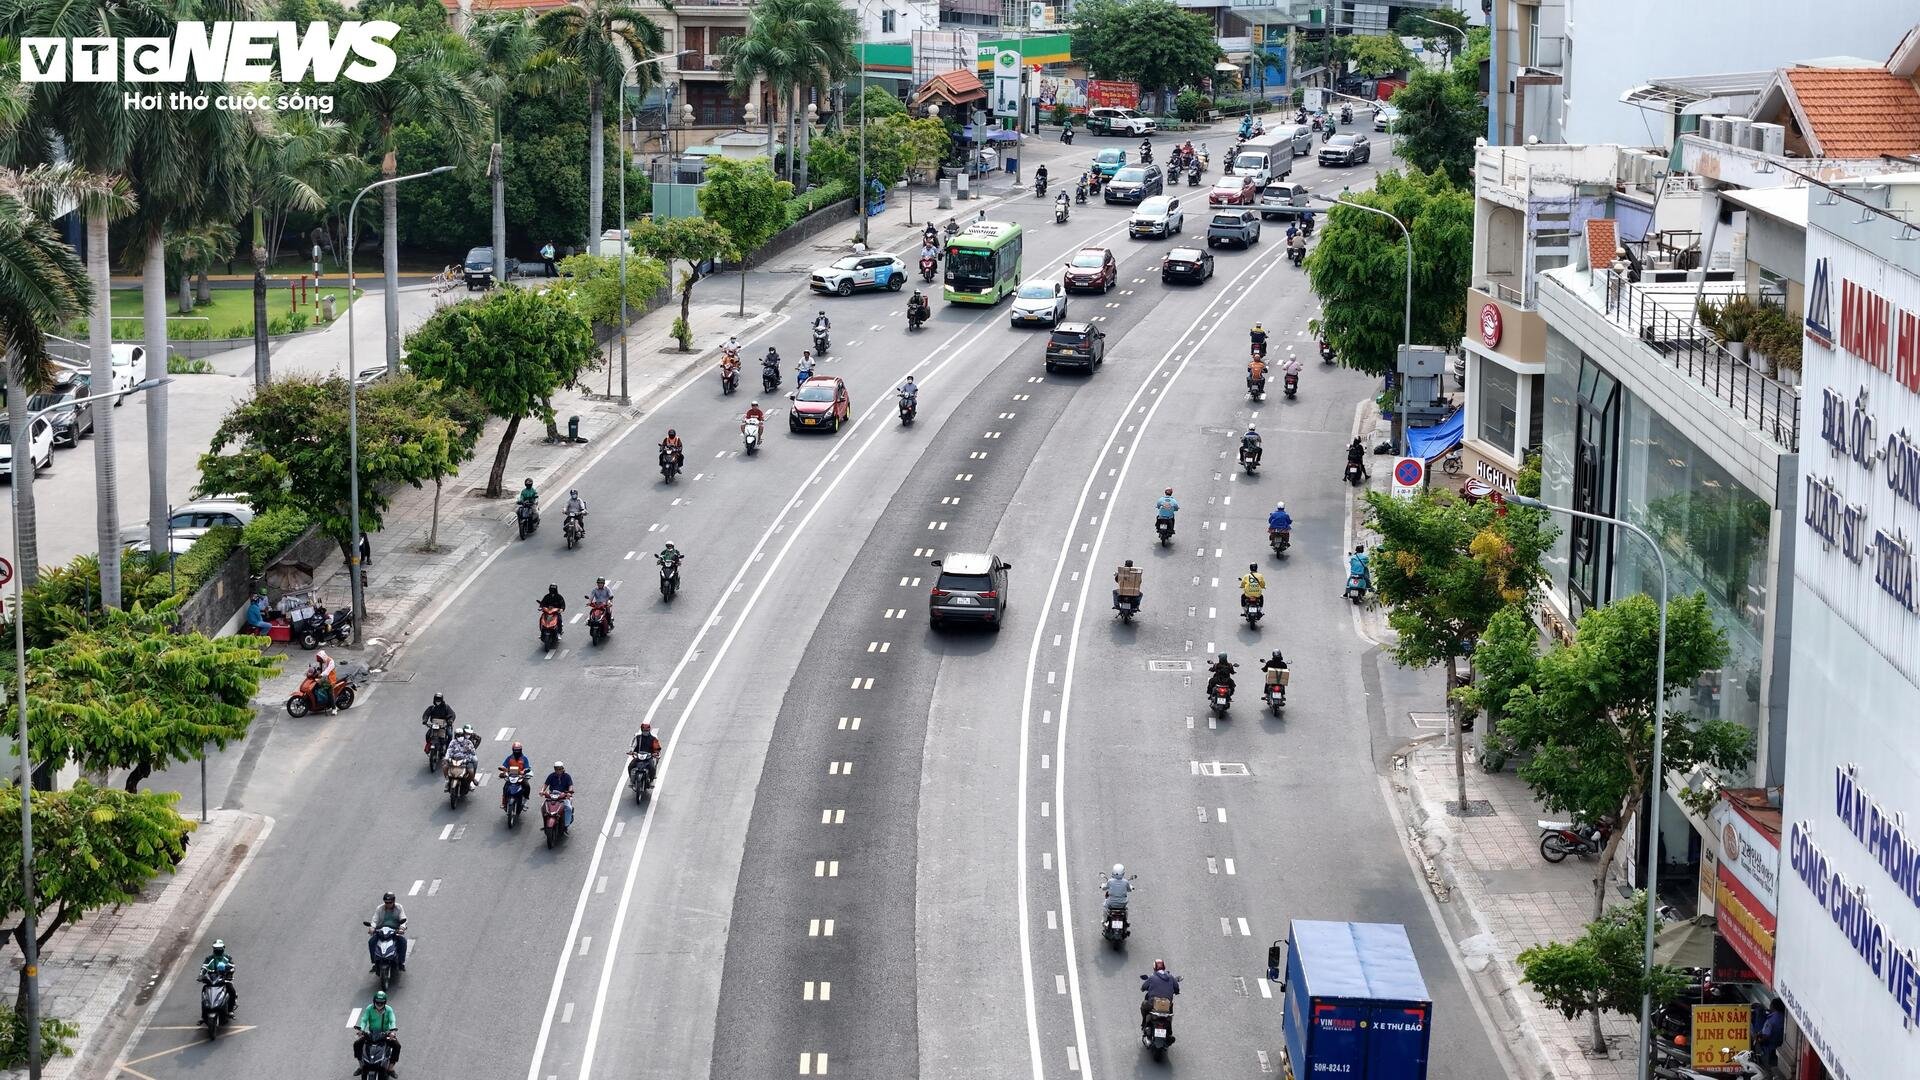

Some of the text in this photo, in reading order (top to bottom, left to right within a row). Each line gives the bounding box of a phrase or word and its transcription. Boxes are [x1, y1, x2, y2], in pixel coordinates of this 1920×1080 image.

[1837, 762, 1868, 844] VĂN
[1790, 820, 1828, 909] CÔNG
[1696, 1008, 1748, 1023] NHÂN SÂM
[1387, 1022, 1404, 1031] THƯ
[1405, 1022, 1423, 1032] BÁO
[1696, 1028, 1748, 1041] LINH CHI
[1696, 1045, 1714, 1063] TỔ
